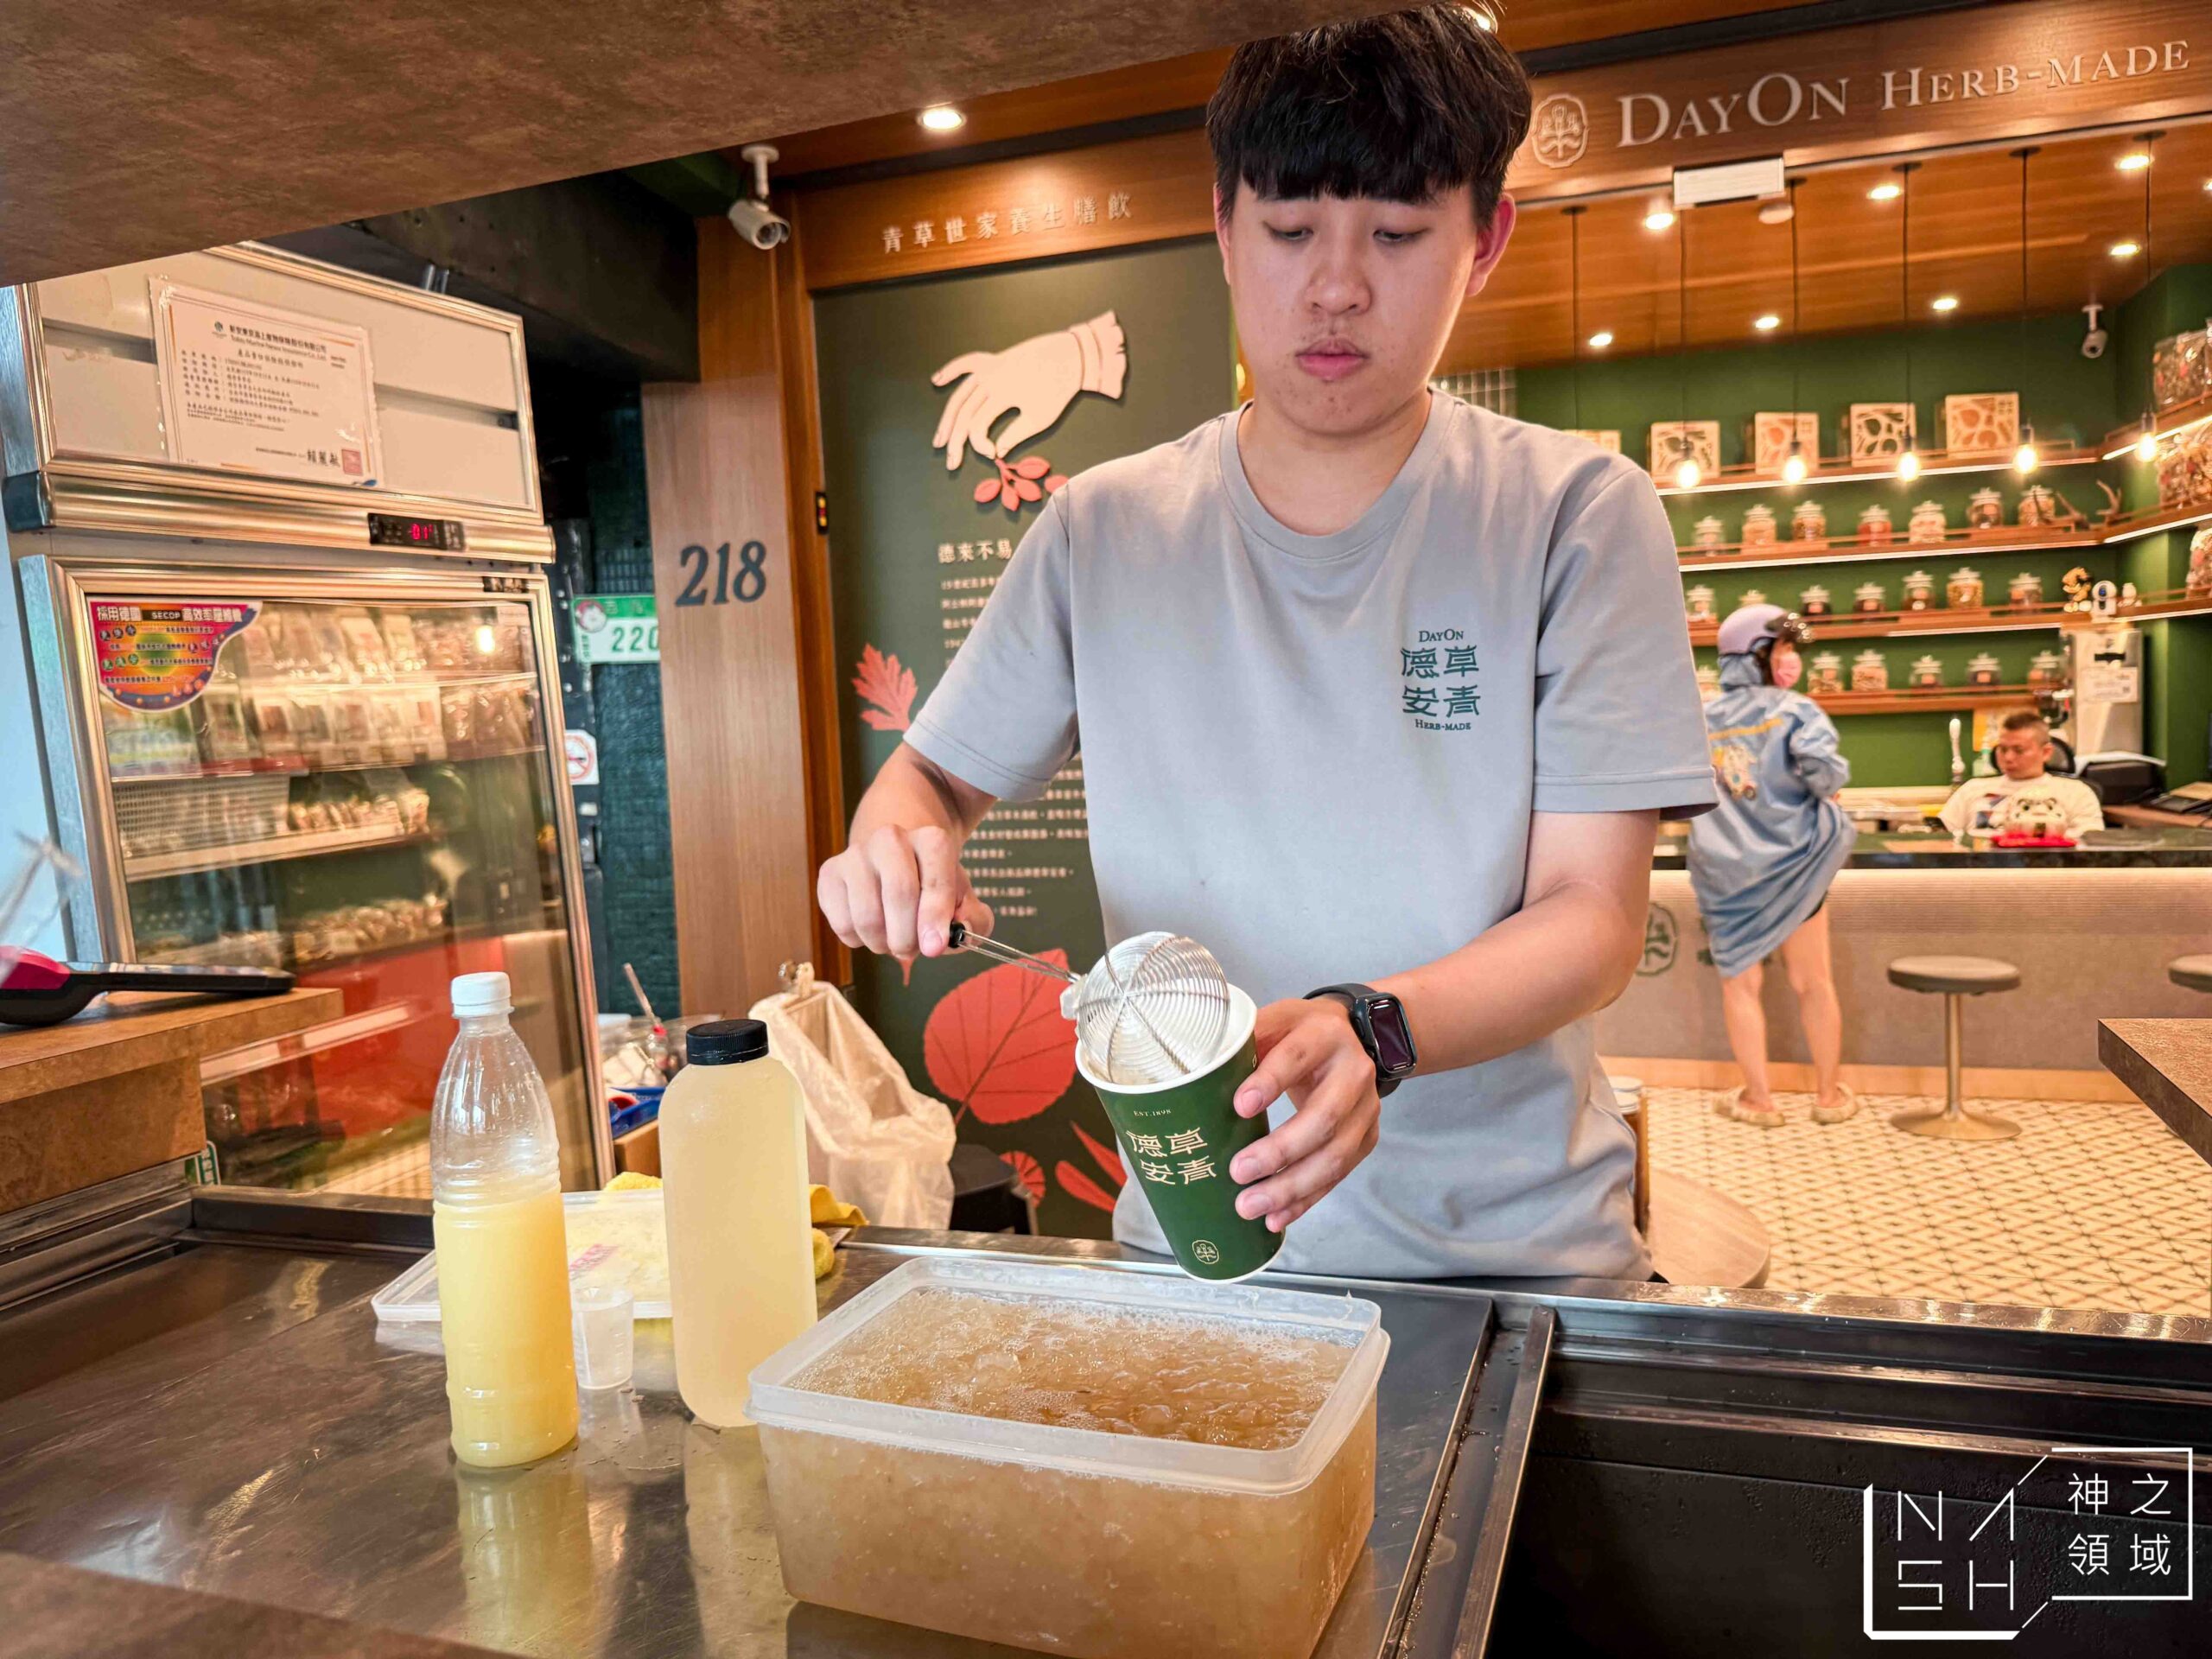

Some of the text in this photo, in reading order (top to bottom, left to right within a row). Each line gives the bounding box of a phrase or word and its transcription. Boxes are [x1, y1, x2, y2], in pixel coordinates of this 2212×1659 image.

[881, 191, 1132, 254] 青草世家養生膳飲
[675, 540, 766, 607] 218
[151, 611, 181, 620] SECOP
